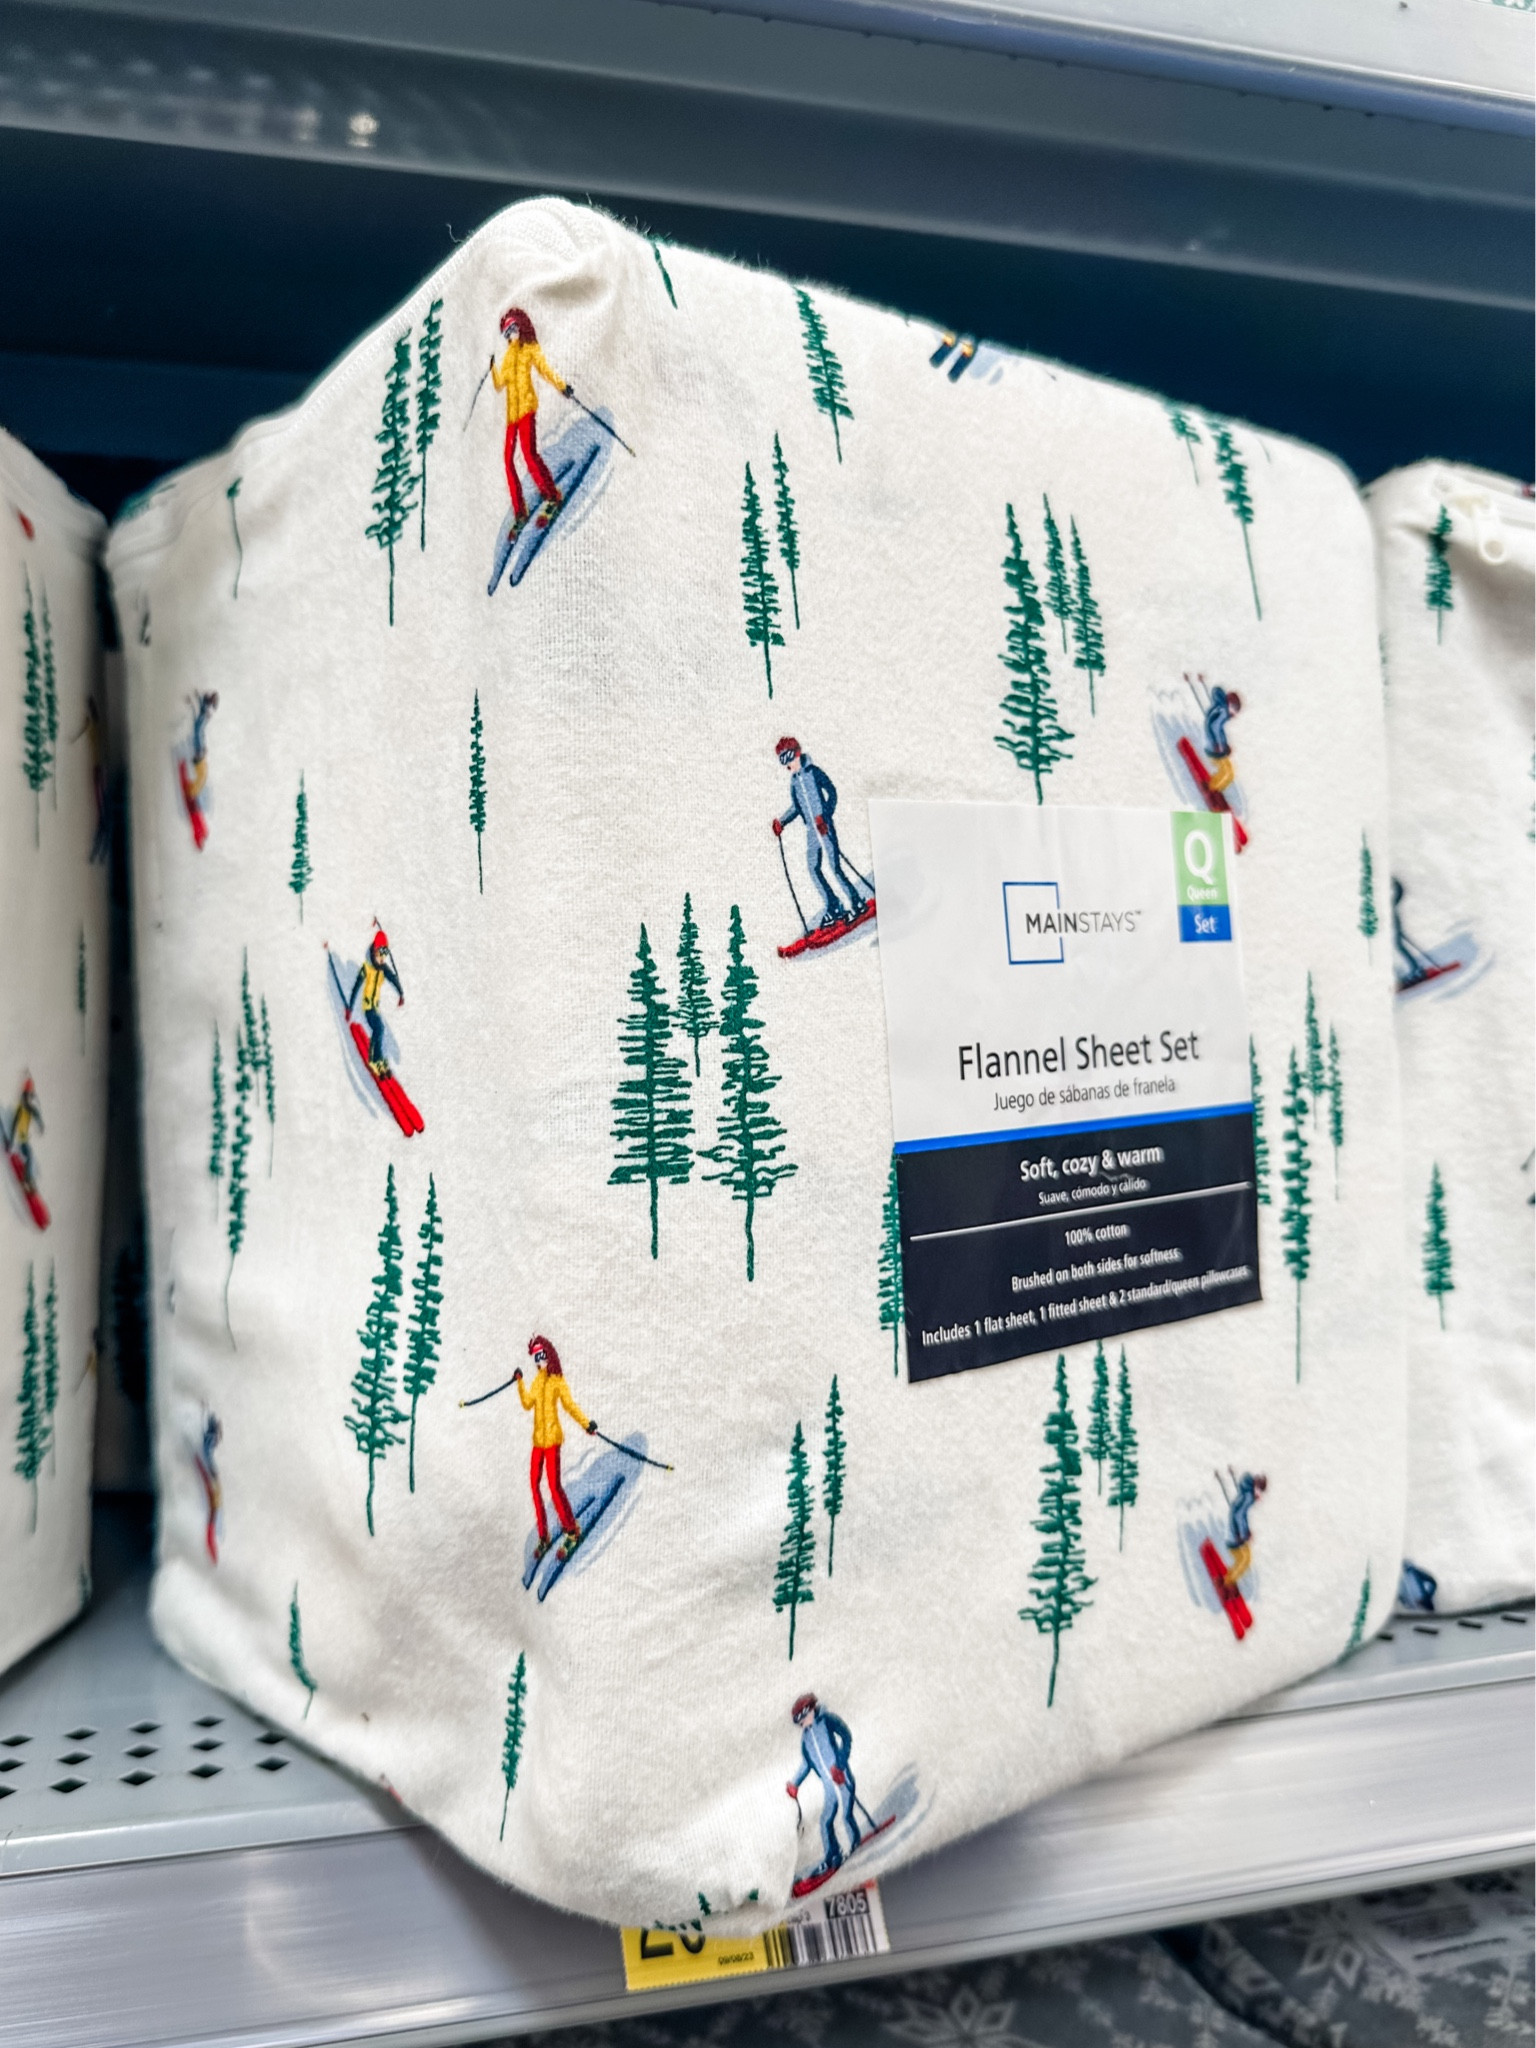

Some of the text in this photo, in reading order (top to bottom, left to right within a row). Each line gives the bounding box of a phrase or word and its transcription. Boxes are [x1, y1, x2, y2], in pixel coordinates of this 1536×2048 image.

[1184, 829, 1214, 886] Q
[1187, 885, 1218, 902] Queen
[1194, 913, 1217, 934] Set
[958, 1030, 1200, 1080] Flannel Sheet Set
[993, 1075, 1176, 1111] Juego de sábanas de franela
[1020, 1146, 1165, 1182] Soft, cozy & warm
[1038, 1178, 1149, 1207] Suave, cómodo y cálido
[1065, 1223, 1131, 1247] 100% cotton
[1011, 1247, 1183, 1293] Brushed on both sides for softness
[922, 1265, 1250, 1347] Includes 1 flat sheet, 1 fitted sheet & 2 standard/queen pillowcases
[826, 1891, 867, 1917] 7805
